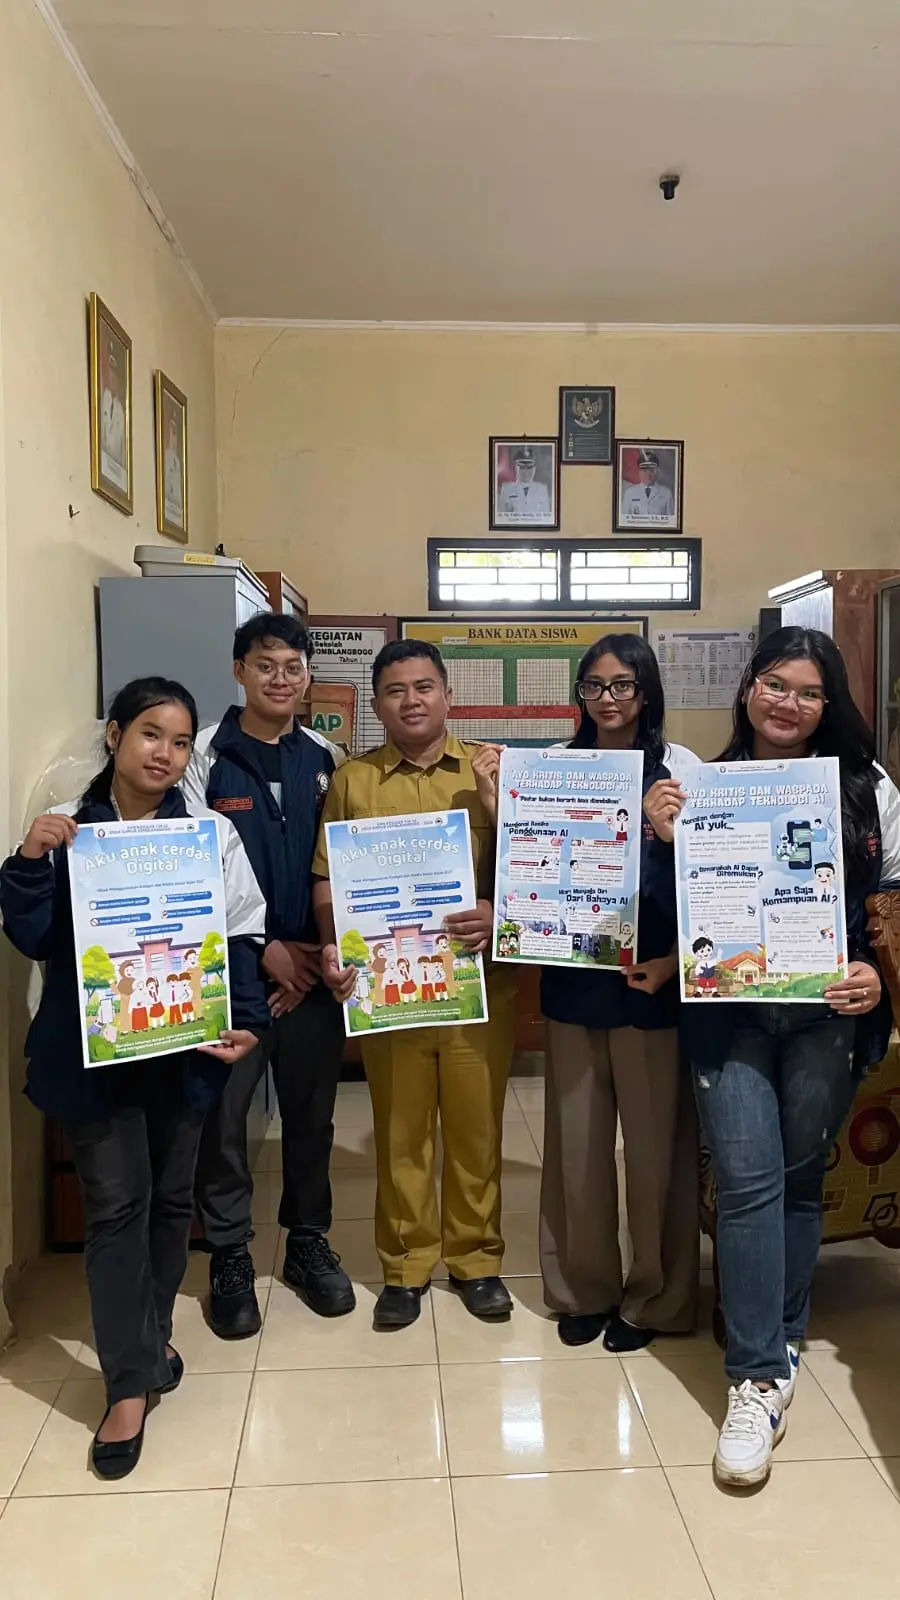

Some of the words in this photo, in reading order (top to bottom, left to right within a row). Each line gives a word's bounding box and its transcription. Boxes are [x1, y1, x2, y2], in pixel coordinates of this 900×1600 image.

[310, 632, 362, 640] KEGIATAN
[468, 628, 501, 639] BANK
[505, 628, 537, 639] DATA
[540, 628, 578, 639] SISWA
[512, 770, 529, 780] AYO
[532, 771, 563, 780] KRITIS
[566, 772, 586, 781] DAN
[588, 772, 632, 782] WASPADA
[516, 780, 563, 789] TERHADAP
[567, 781, 616, 792] TEKNOLOGI
[620, 782, 630, 792] AI
[687, 788, 706, 798] AYO
[710, 788, 745, 798] KRITIS
[750, 786, 771, 796] DAN
[776, 784, 828, 794] WASPADA
[691, 798, 745, 808] TERHADAP
[750, 796, 809, 806] TEKNOLOGI
[813, 795, 825, 804] AI
[504, 821, 530, 829] Mengenal
[682, 816, 708, 826] Kenalan
[709, 812, 734, 820] dengan
[509, 828, 557, 837] Penggunaan
[560, 828, 568, 837] AI
[694, 822, 704, 831] AI
[85, 852, 116, 872] Aku
[120, 842, 158, 860] anak
[162, 844, 211, 862] cerdas
[341, 846, 368, 865] Aku
[372, 837, 406, 853] anak
[410, 837, 460, 854] cerdas
[377, 852, 426, 867] Digital
[126, 858, 178, 875] Digital
[774, 888, 791, 897] Apa
[794, 886, 814, 895] Saja
[586, 895, 616, 905] Bahaya
[620, 897, 628, 905] AI
[762, 896, 818, 906] Kemampuan
